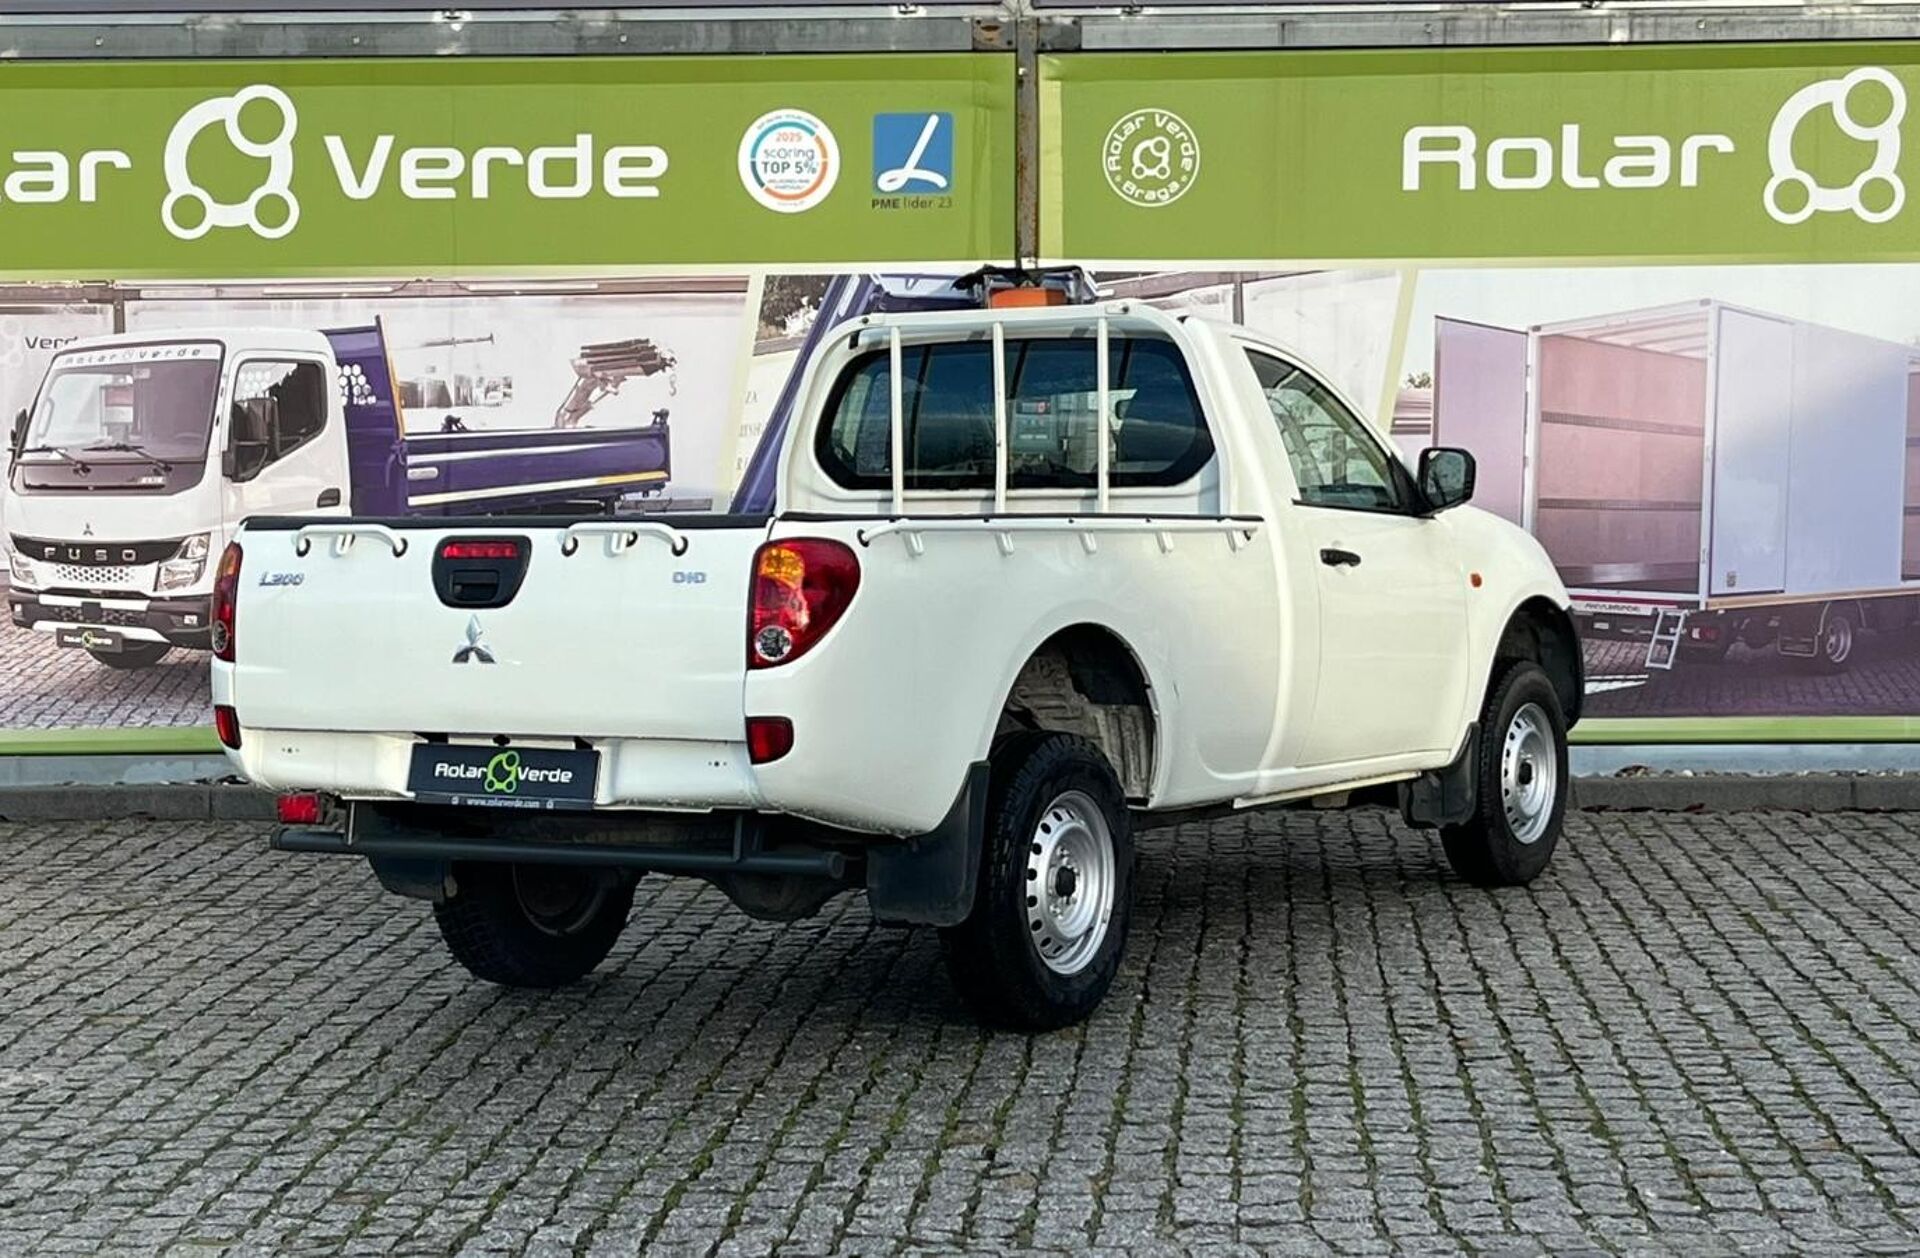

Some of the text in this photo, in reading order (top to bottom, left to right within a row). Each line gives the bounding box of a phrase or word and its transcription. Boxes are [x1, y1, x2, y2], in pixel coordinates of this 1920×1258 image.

[776, 131, 802, 142] 2025
[1107, 113, 1195, 172] Rolar Verde
[1403, 123, 1735, 190] Rolar
[0, 133, 669, 203] ar Verde
[761, 160, 818, 174] TOP 5%
[1121, 180, 1180, 201] Braga
[871, 198, 900, 209] PME
[44, 547, 136, 561] FUSO
[258, 571, 305, 586] L200
[434, 763, 573, 783] Rolar Verde
